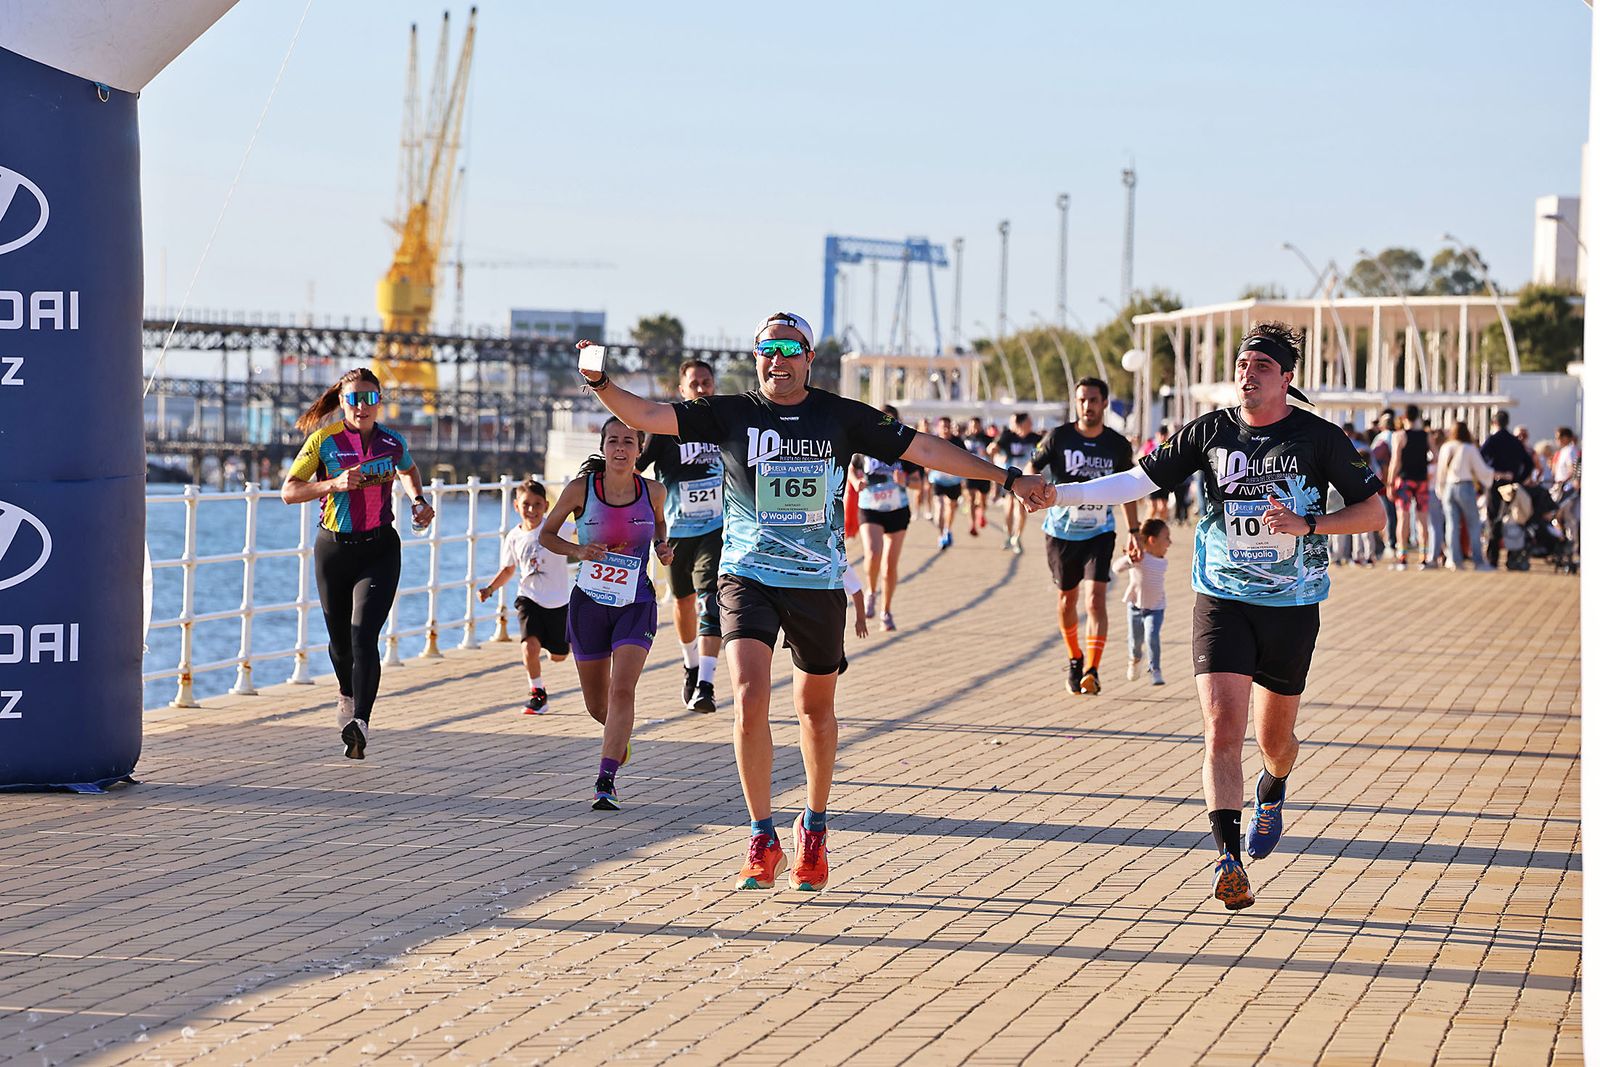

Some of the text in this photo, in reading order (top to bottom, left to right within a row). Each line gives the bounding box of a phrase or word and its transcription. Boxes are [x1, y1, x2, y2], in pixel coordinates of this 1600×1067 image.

[747, 427, 832, 467] 10 HUELVA
[1084, 456, 1114, 469] HUELVA
[1246, 456, 1298, 477] HUELVA
[689, 488, 716, 503] 521
[769, 478, 817, 498] 165
[768, 512, 803, 522] Wayalia
[1240, 550, 1273, 559] Wayalia
[590, 563, 629, 585] 322
